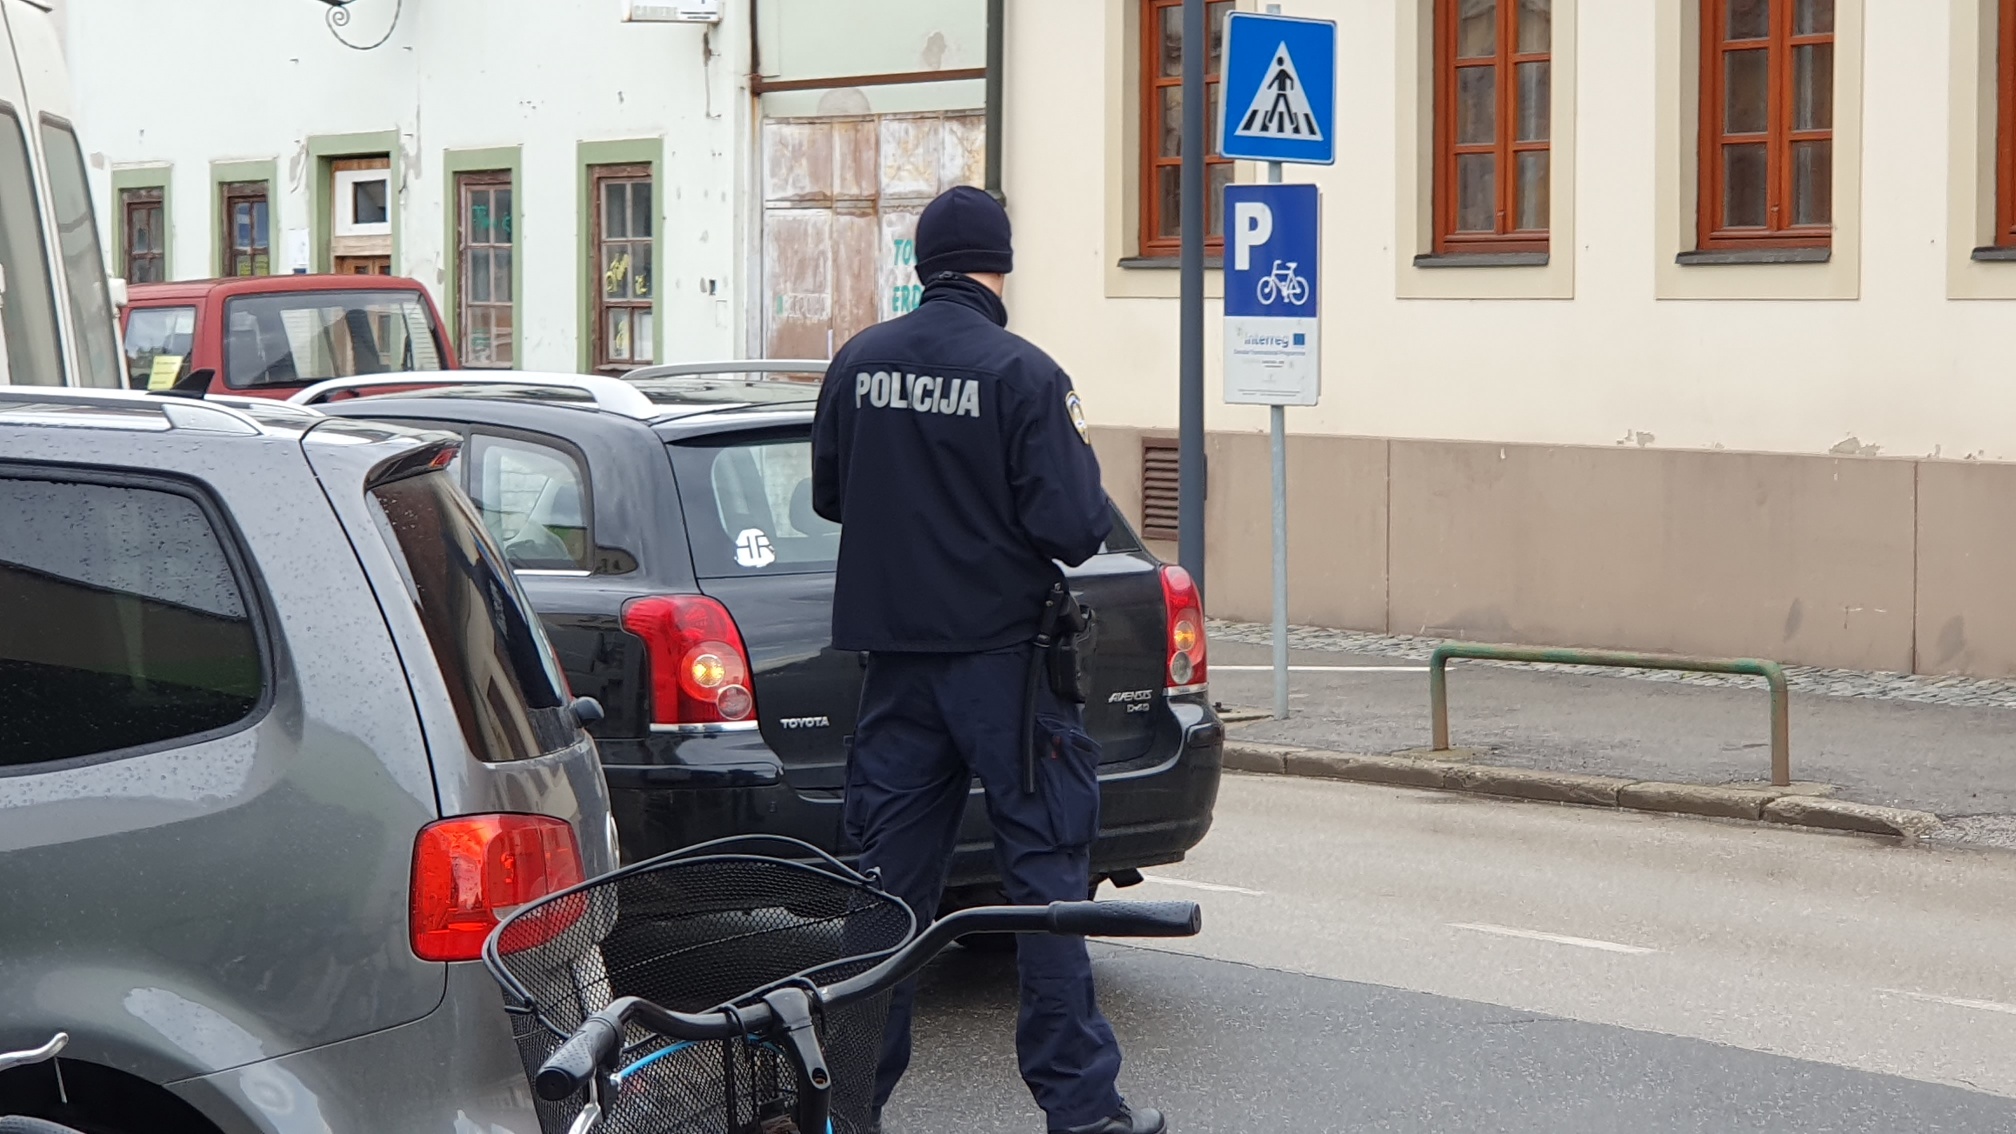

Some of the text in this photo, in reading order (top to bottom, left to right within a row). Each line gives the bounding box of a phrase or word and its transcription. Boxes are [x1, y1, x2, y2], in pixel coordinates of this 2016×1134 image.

[893, 239, 918, 266] TO
[1235, 202, 1273, 271] P
[856, 371, 981, 418] POLICIJA
[780, 716, 830, 729] TOYOTA
